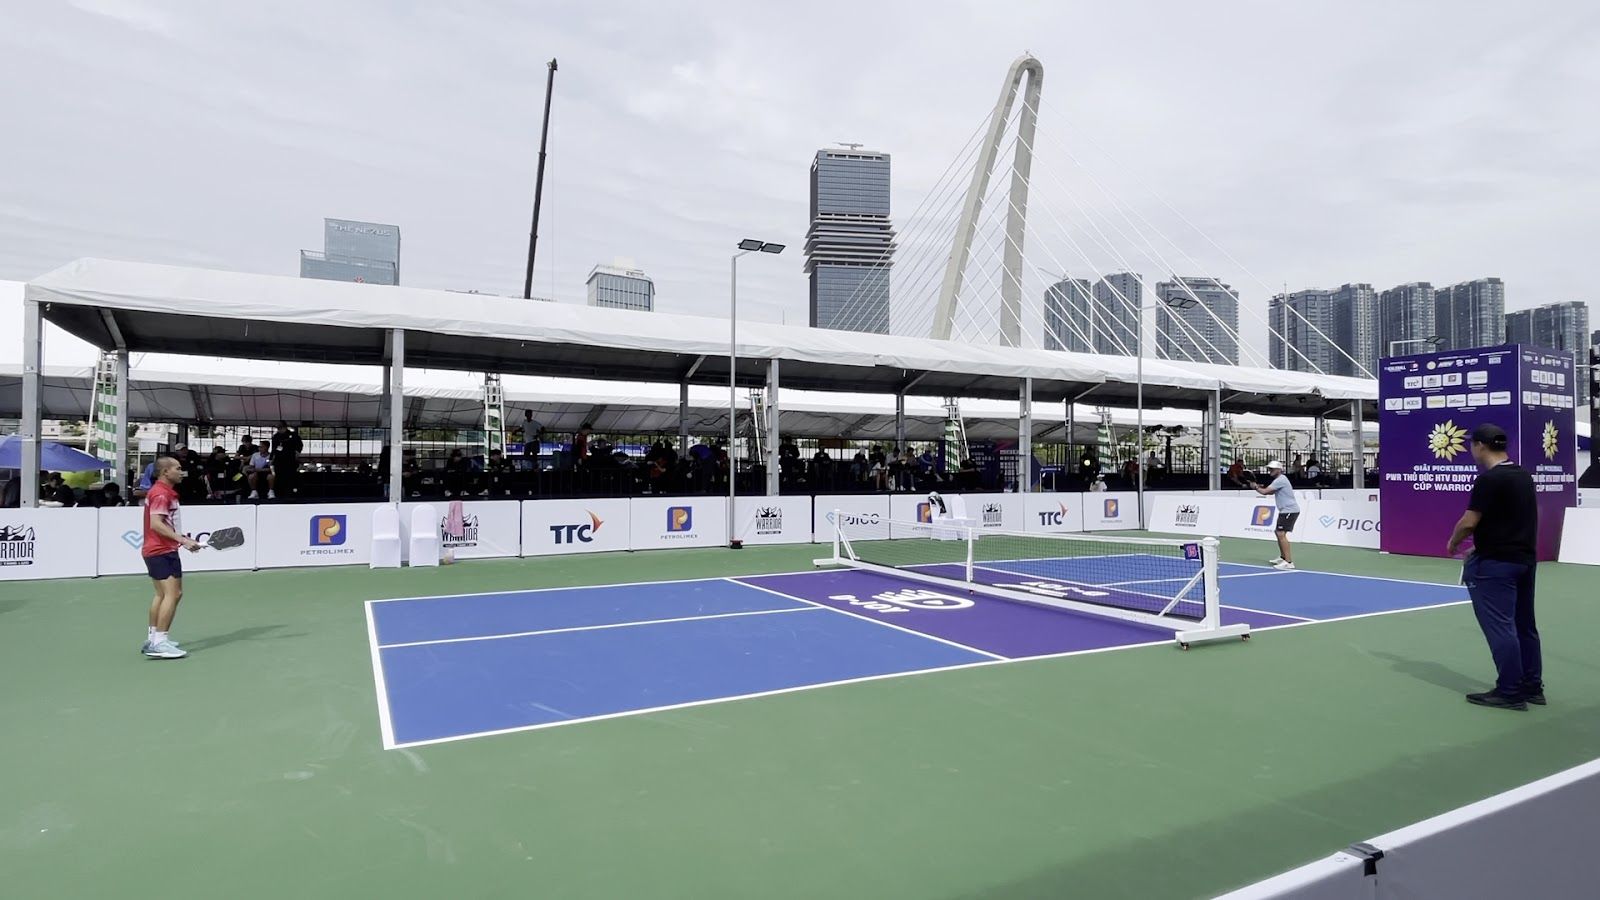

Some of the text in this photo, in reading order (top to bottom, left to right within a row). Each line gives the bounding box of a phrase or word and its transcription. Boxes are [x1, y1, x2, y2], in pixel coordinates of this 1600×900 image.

[1385, 473, 1402, 481] PWR
[1435, 474, 1451, 482] HTV
[1452, 474, 1472, 483] DJOY
[1413, 481, 1474, 492] CÚP WARRIO
[1039, 511, 1062, 526] TTC
[550, 524, 594, 544] TTC
